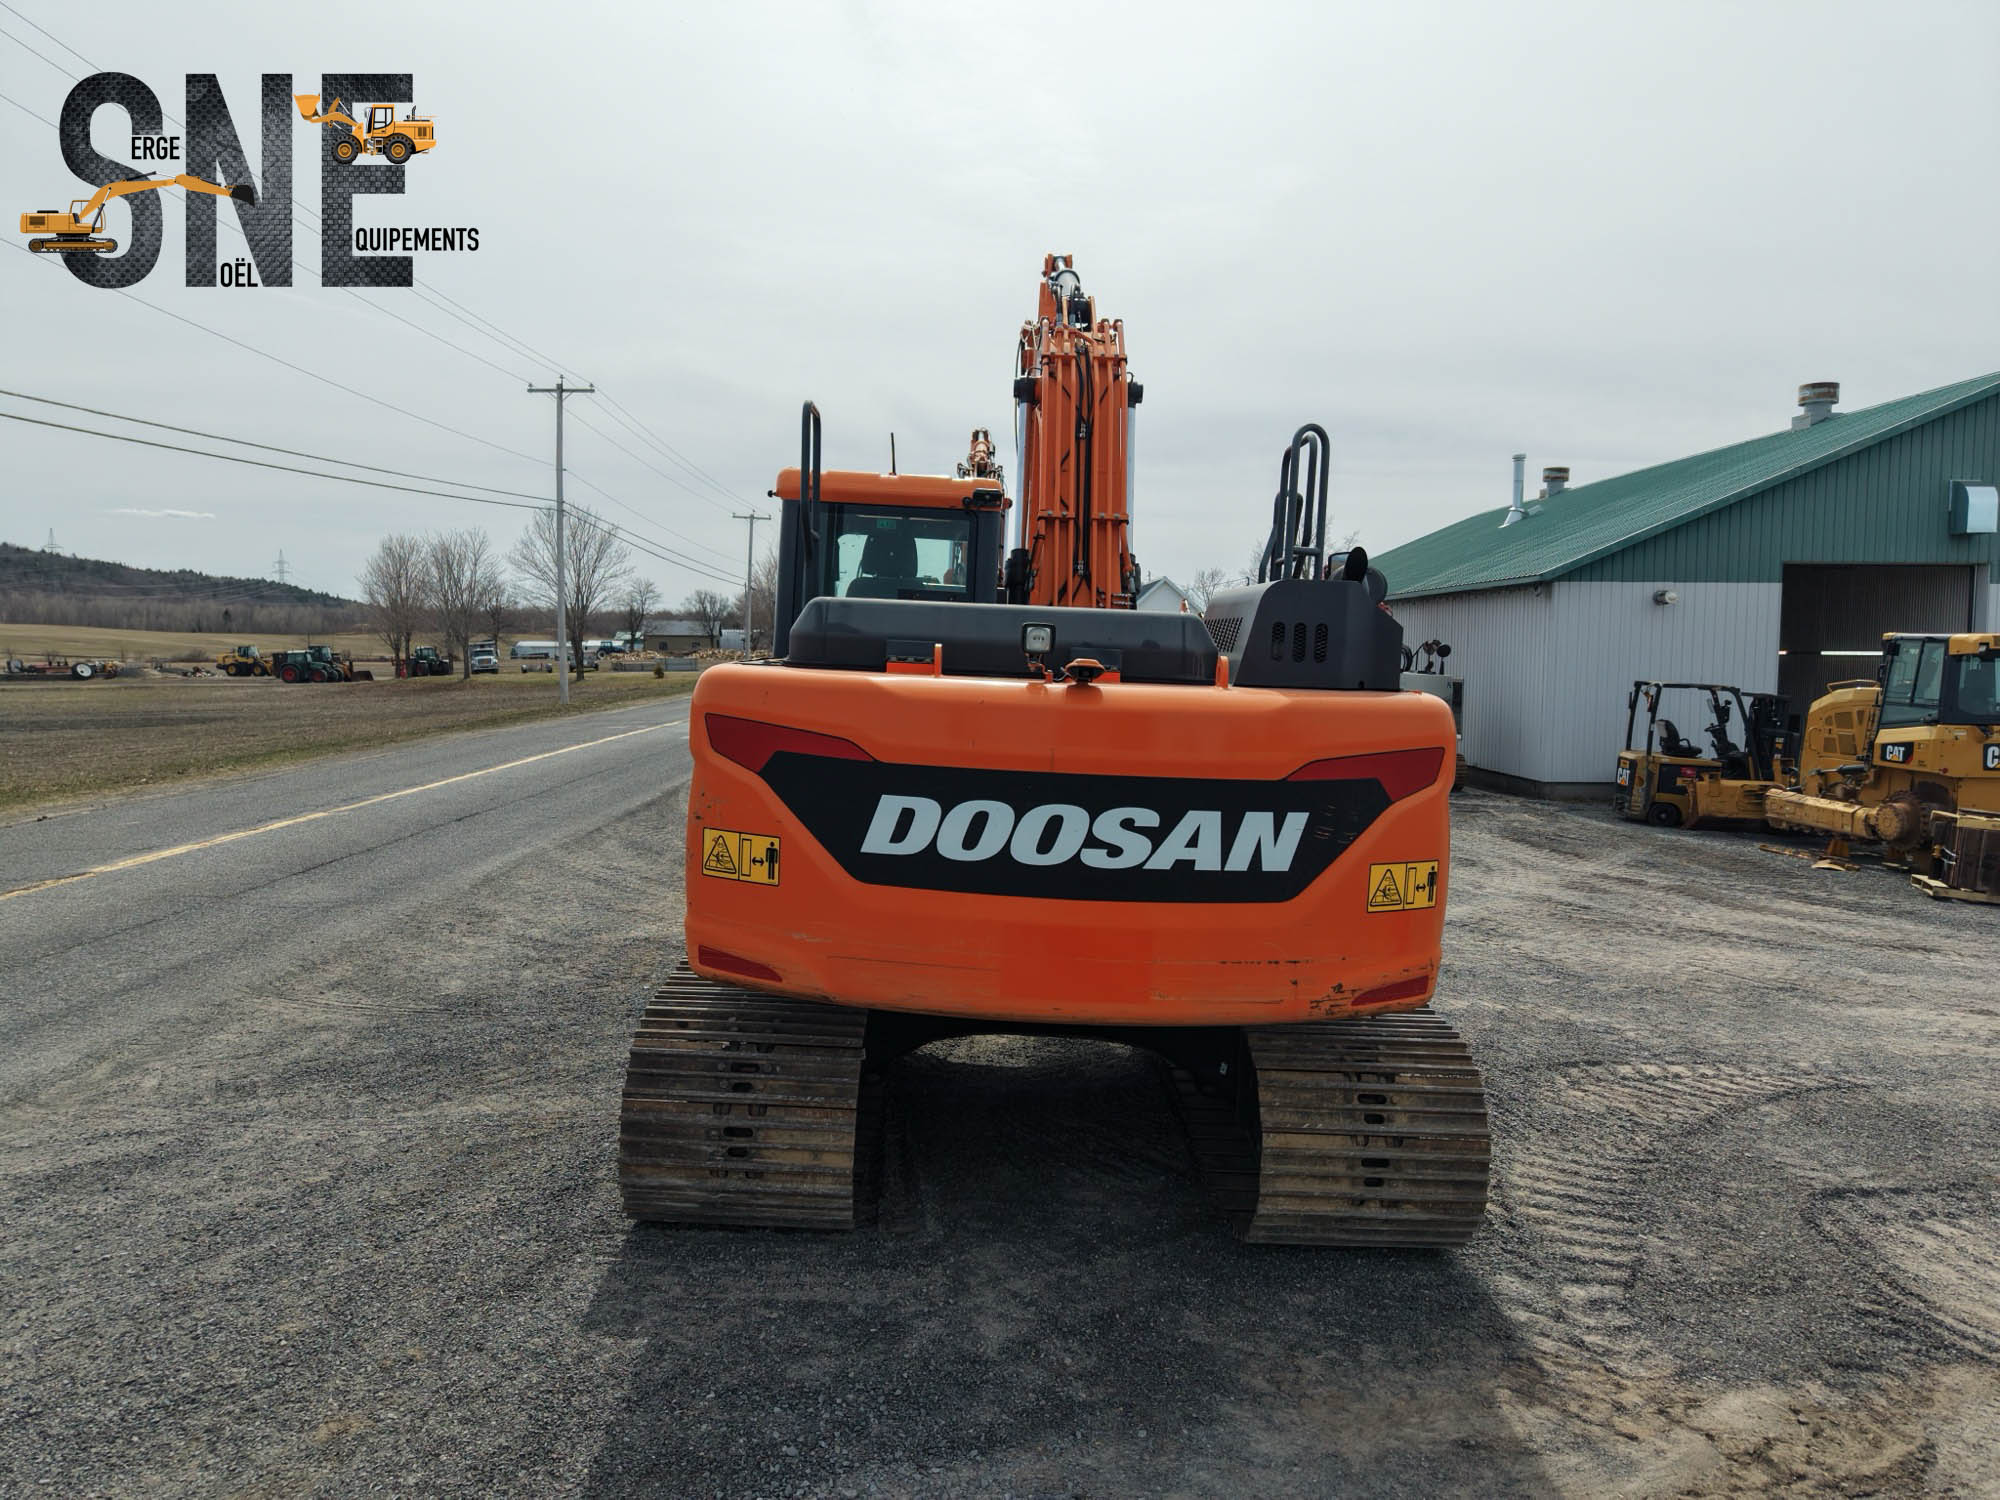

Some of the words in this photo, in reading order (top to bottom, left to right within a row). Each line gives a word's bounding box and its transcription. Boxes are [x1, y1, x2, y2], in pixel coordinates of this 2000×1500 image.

[1885, 744, 1905, 762] CAT
[1616, 767, 1631, 787] CAT
[860, 794, 1310, 872] DOOSAN
